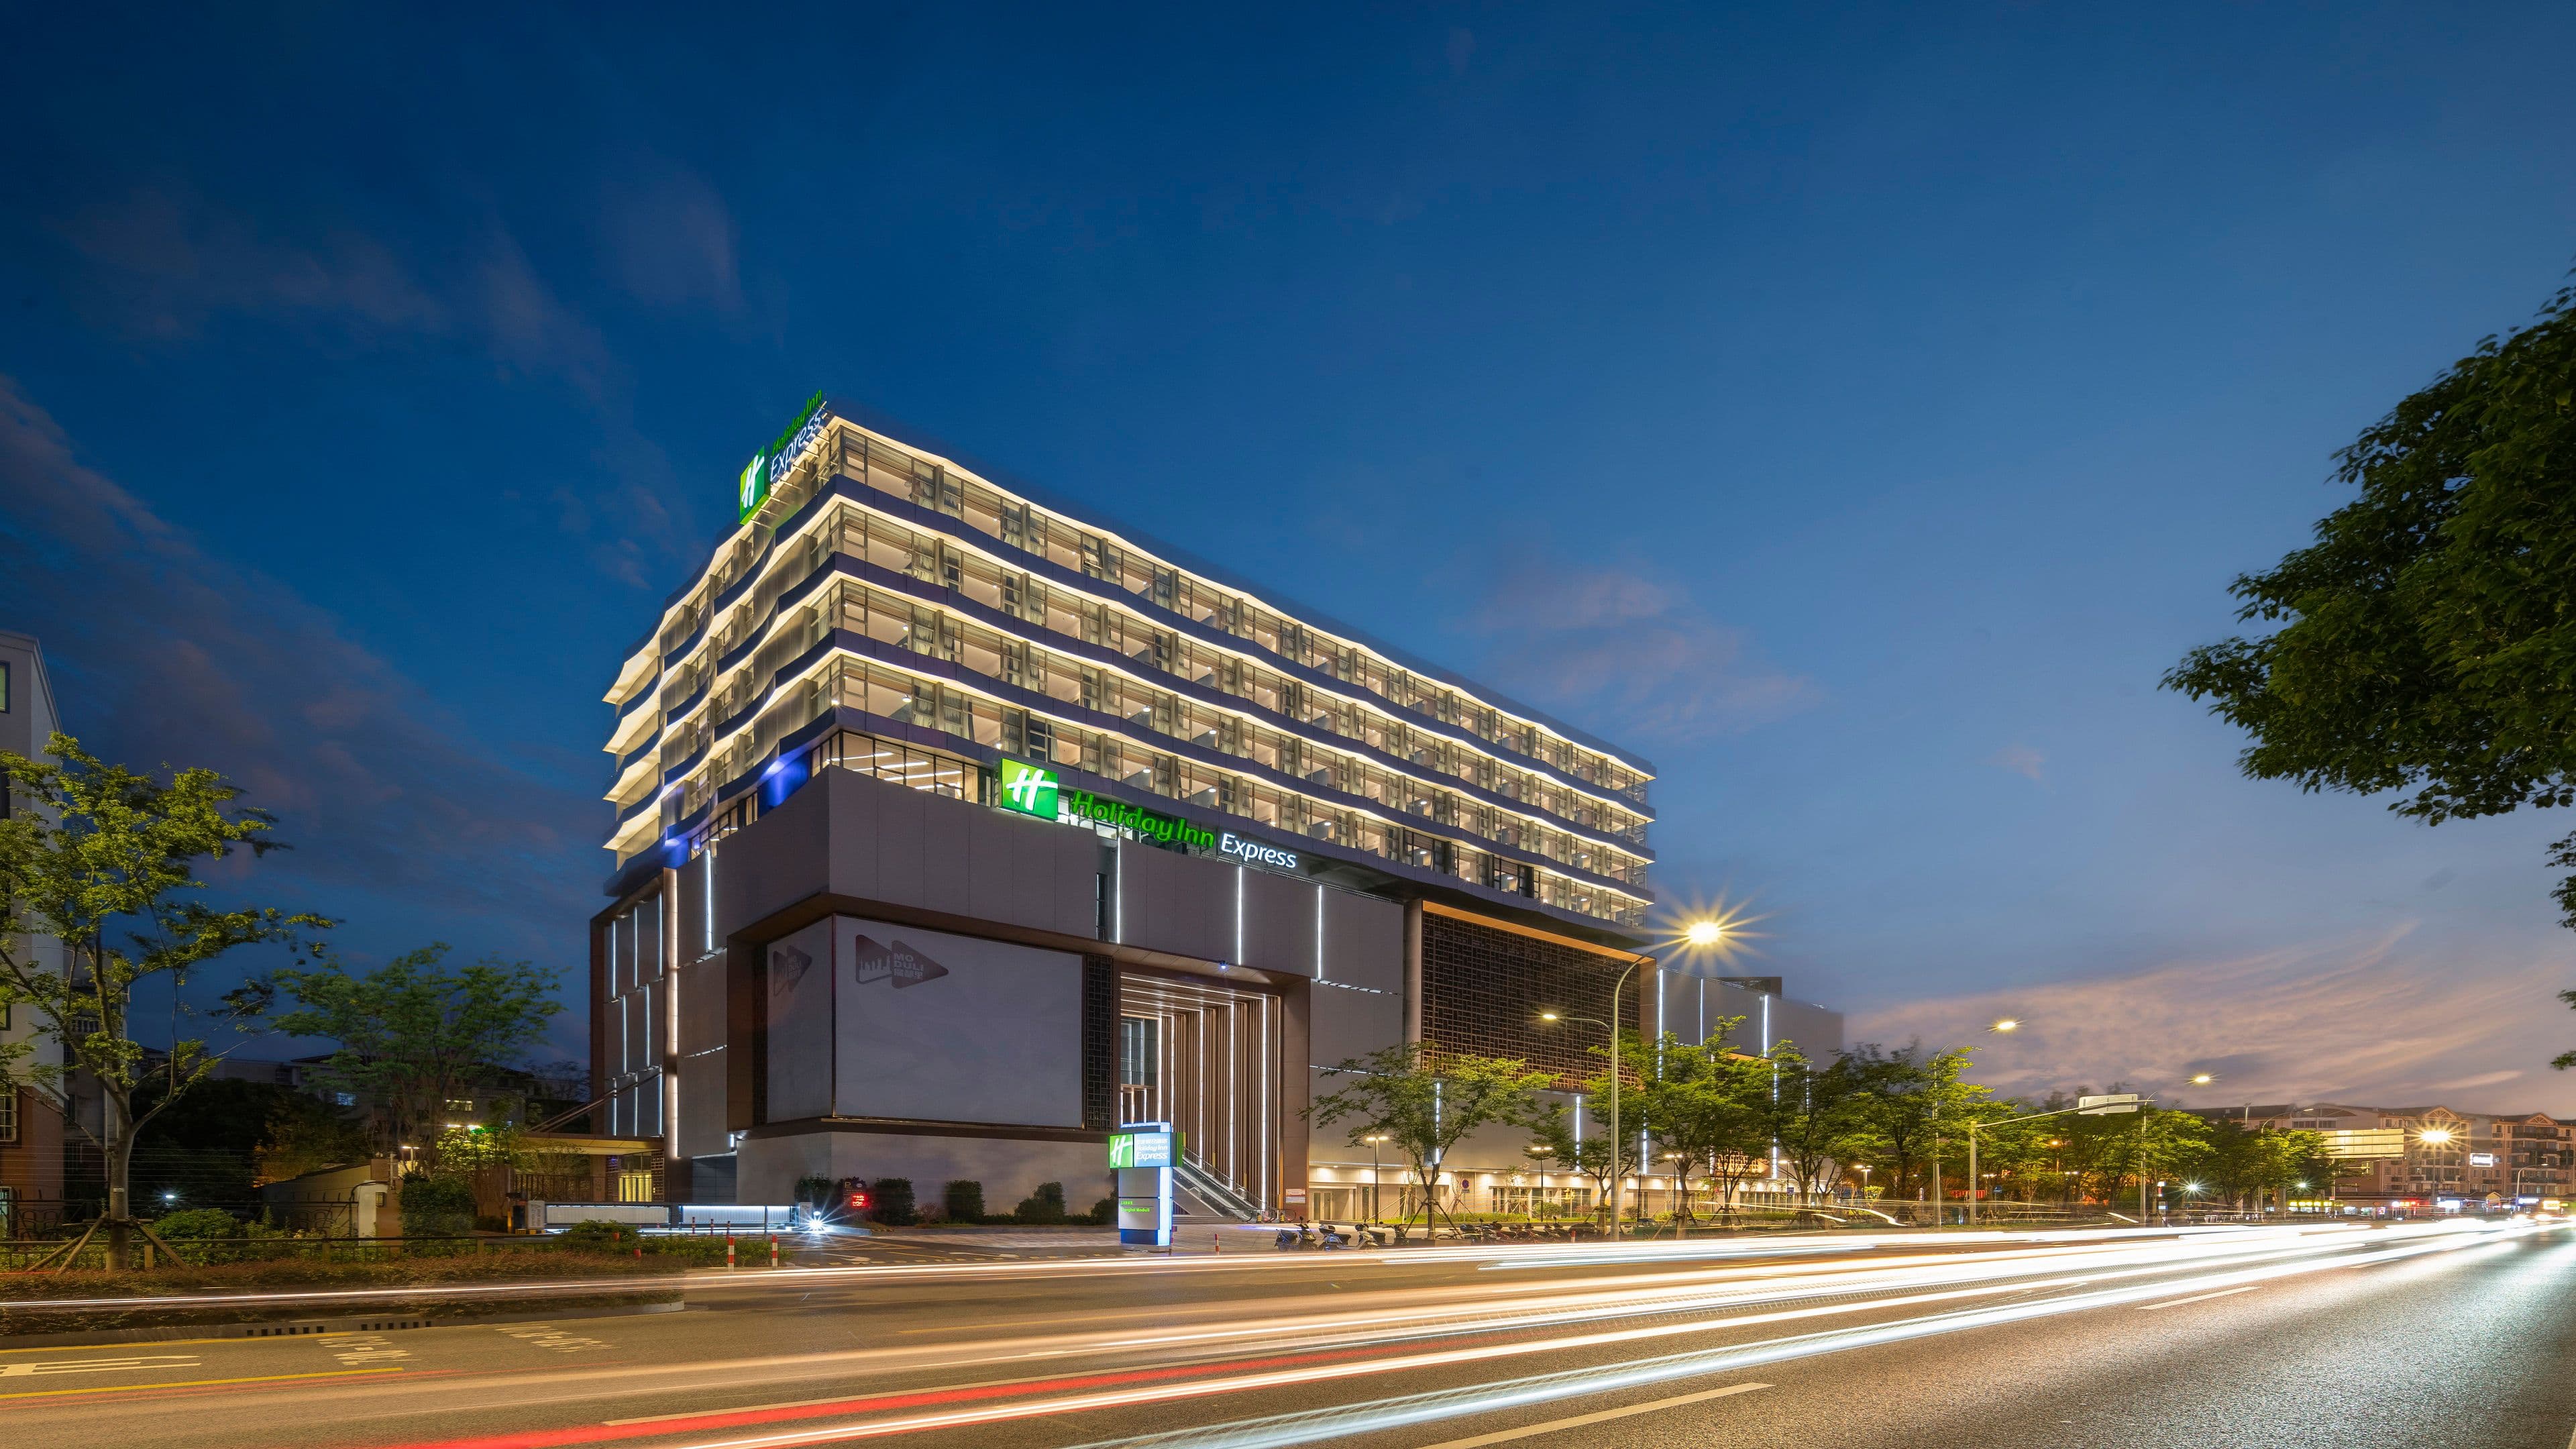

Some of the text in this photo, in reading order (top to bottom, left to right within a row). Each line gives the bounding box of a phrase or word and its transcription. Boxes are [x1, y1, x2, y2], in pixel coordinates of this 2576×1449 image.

[770, 408, 823, 482] Express
[1071, 790, 1297, 870] Holiday Inn Express
[1136, 1152, 1168, 1162] Express
